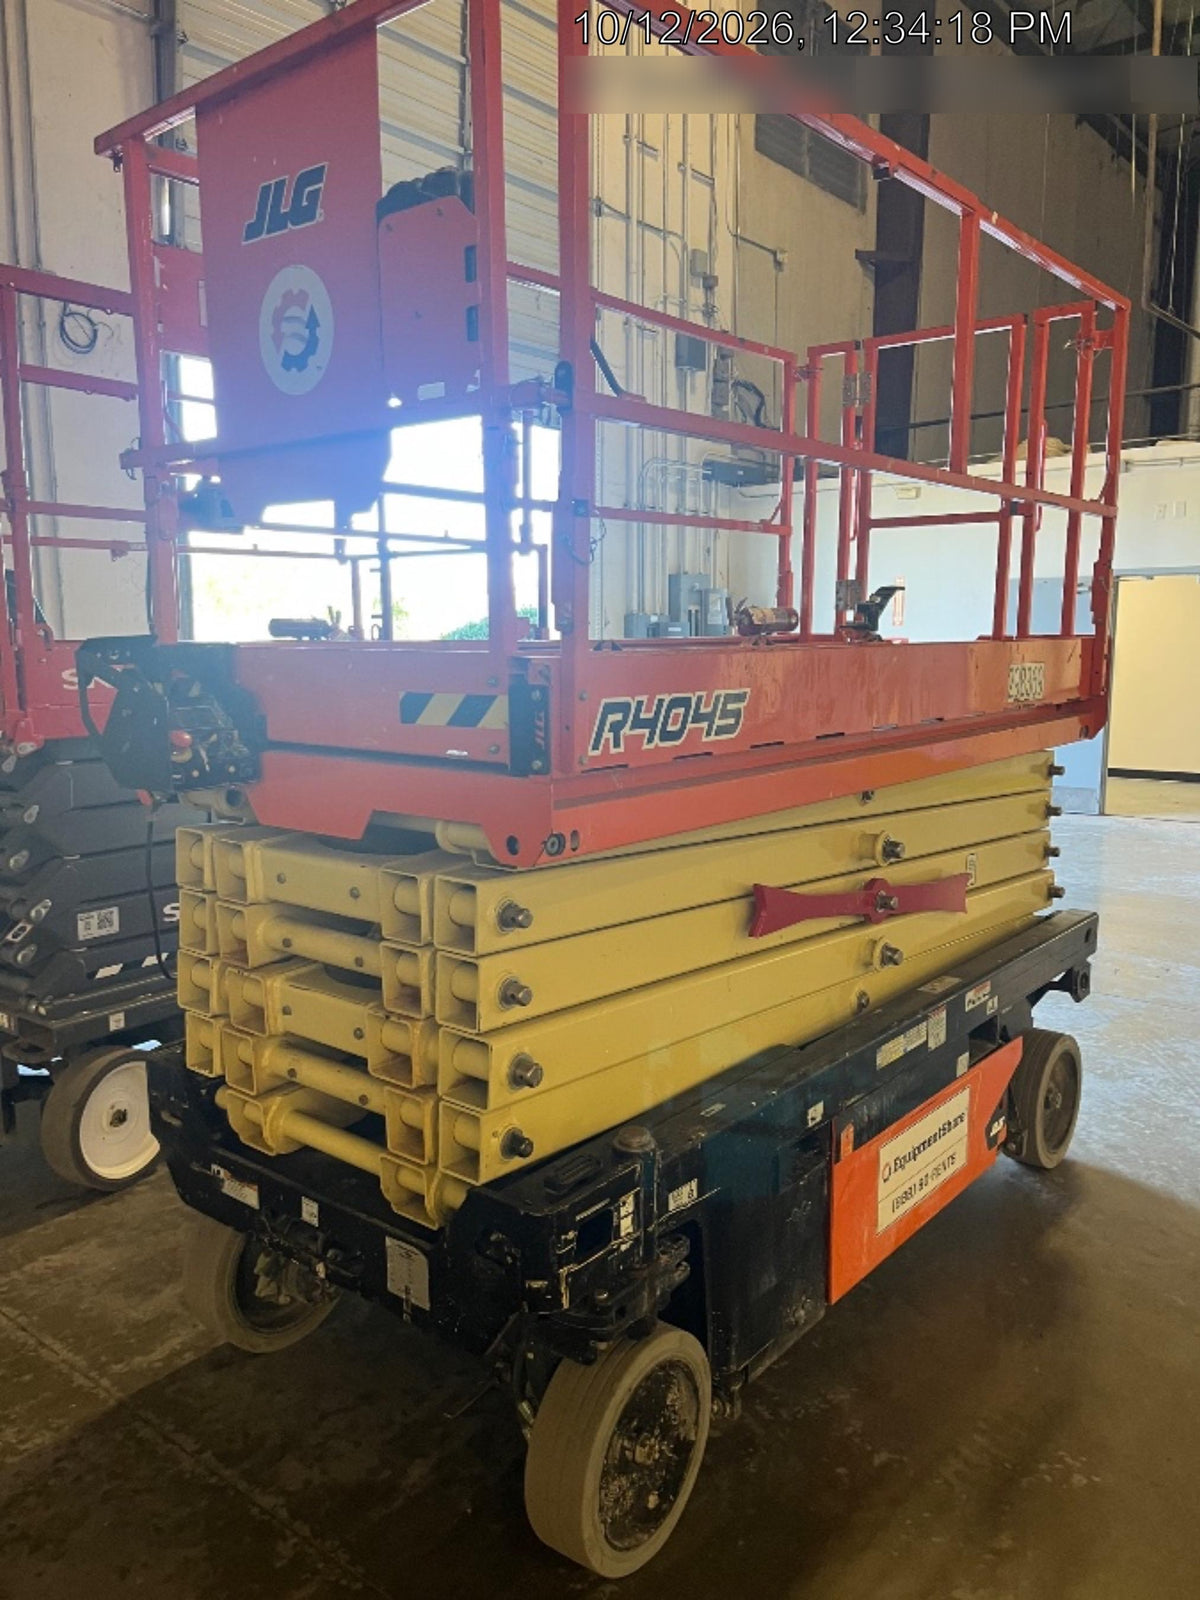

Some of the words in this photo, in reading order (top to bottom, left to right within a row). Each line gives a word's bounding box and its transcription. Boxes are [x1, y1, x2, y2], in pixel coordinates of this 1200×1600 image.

[241, 161, 329, 246] JLG
[588, 687, 752, 756] R4045
[892, 1111, 966, 1173] EquipmentShare
